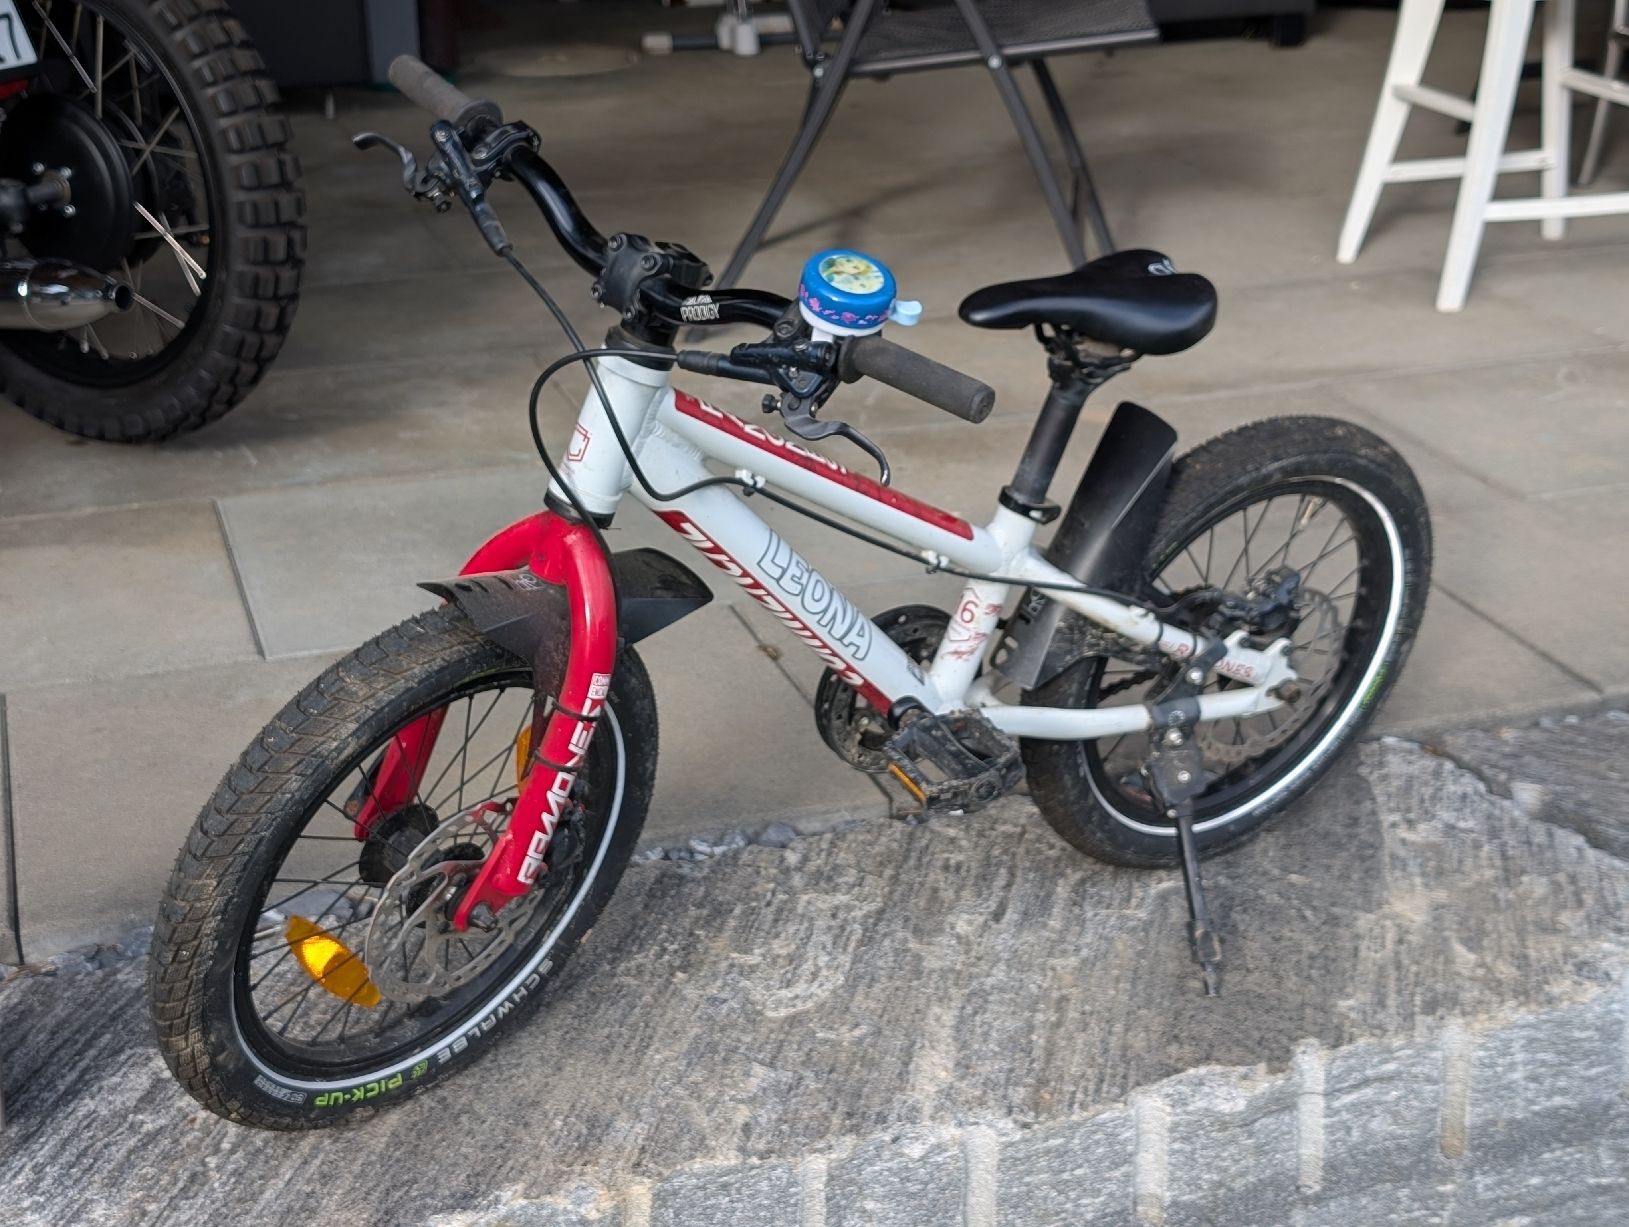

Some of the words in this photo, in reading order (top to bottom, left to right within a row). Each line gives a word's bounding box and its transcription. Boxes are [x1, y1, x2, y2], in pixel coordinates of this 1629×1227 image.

[680, 303, 720, 321] PRODIGY
[757, 528, 873, 661] LEONA
[436, 958, 554, 1065] SCHWALBE
[313, 1075, 404, 1108] PICK-UP
